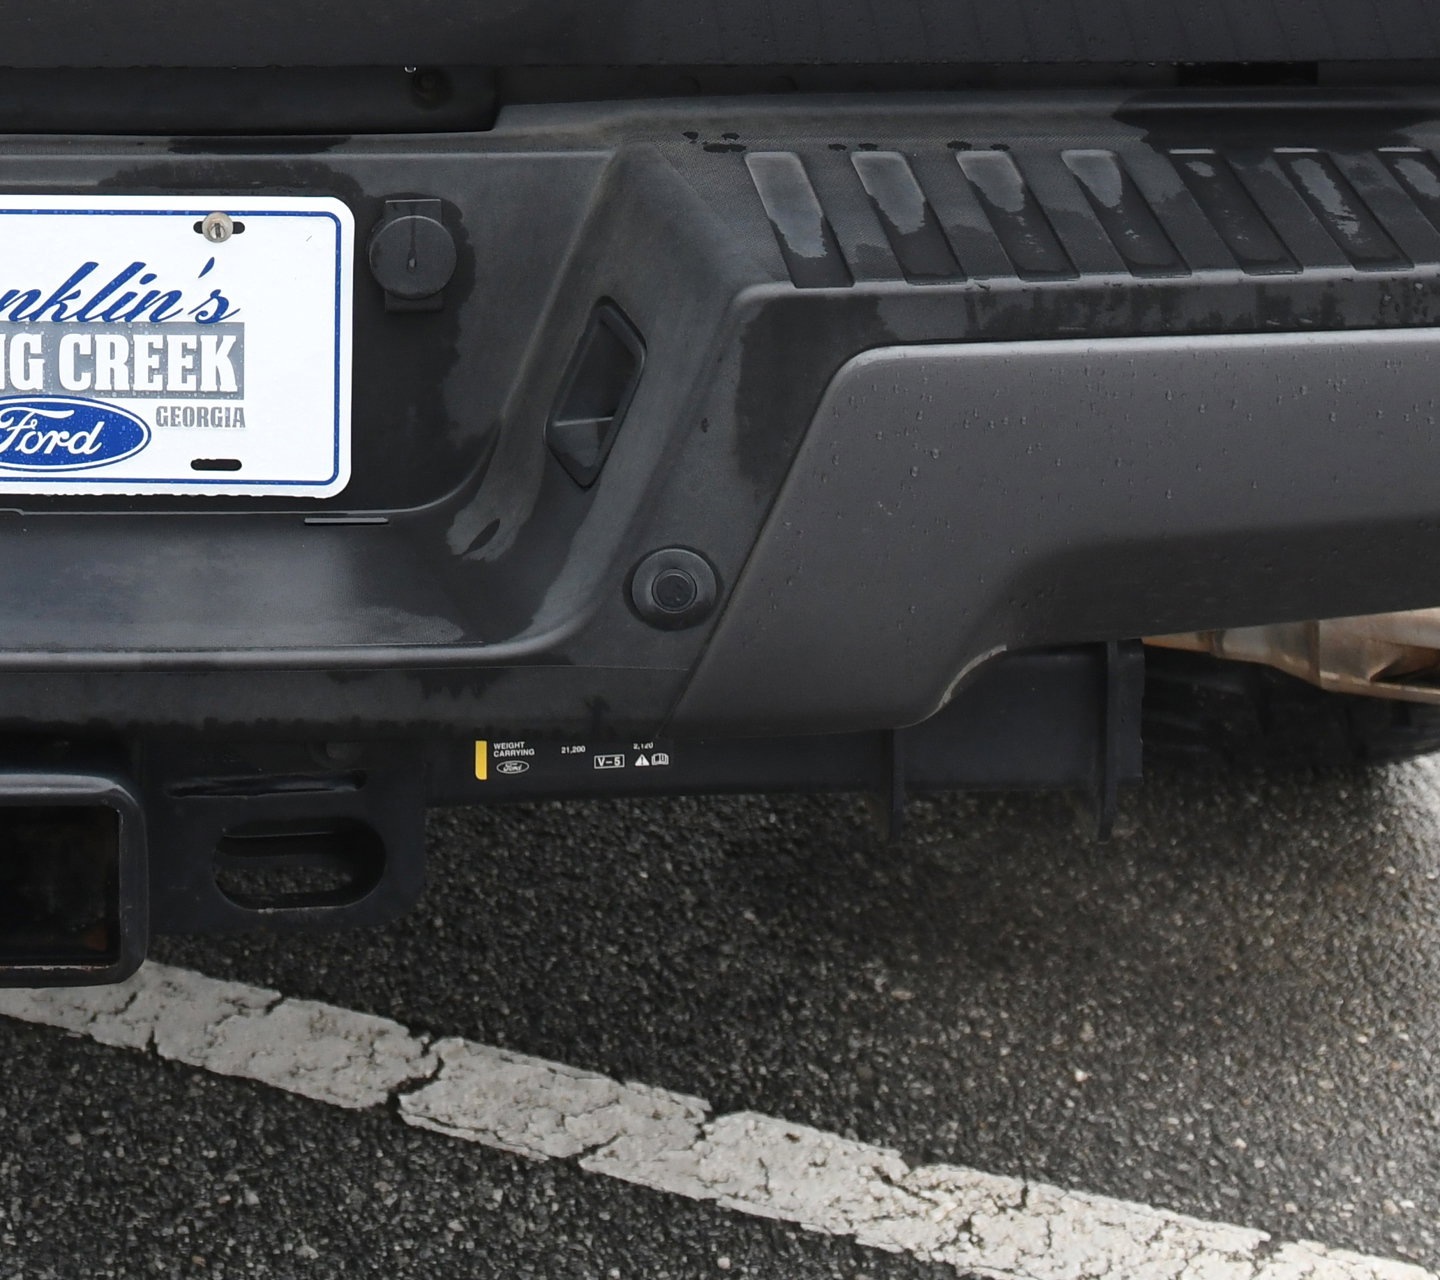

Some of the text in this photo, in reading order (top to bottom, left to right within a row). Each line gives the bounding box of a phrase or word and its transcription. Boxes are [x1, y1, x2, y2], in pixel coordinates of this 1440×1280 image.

[57, 332, 239, 393] CREEK
[155, 405, 247, 429] GEORGIA
[493, 741, 525, 750] WEIGHT
[561, 745, 586, 755] 21,200
[493, 747, 535, 758] CARRYING
[502, 760, 524, 773] Ford
